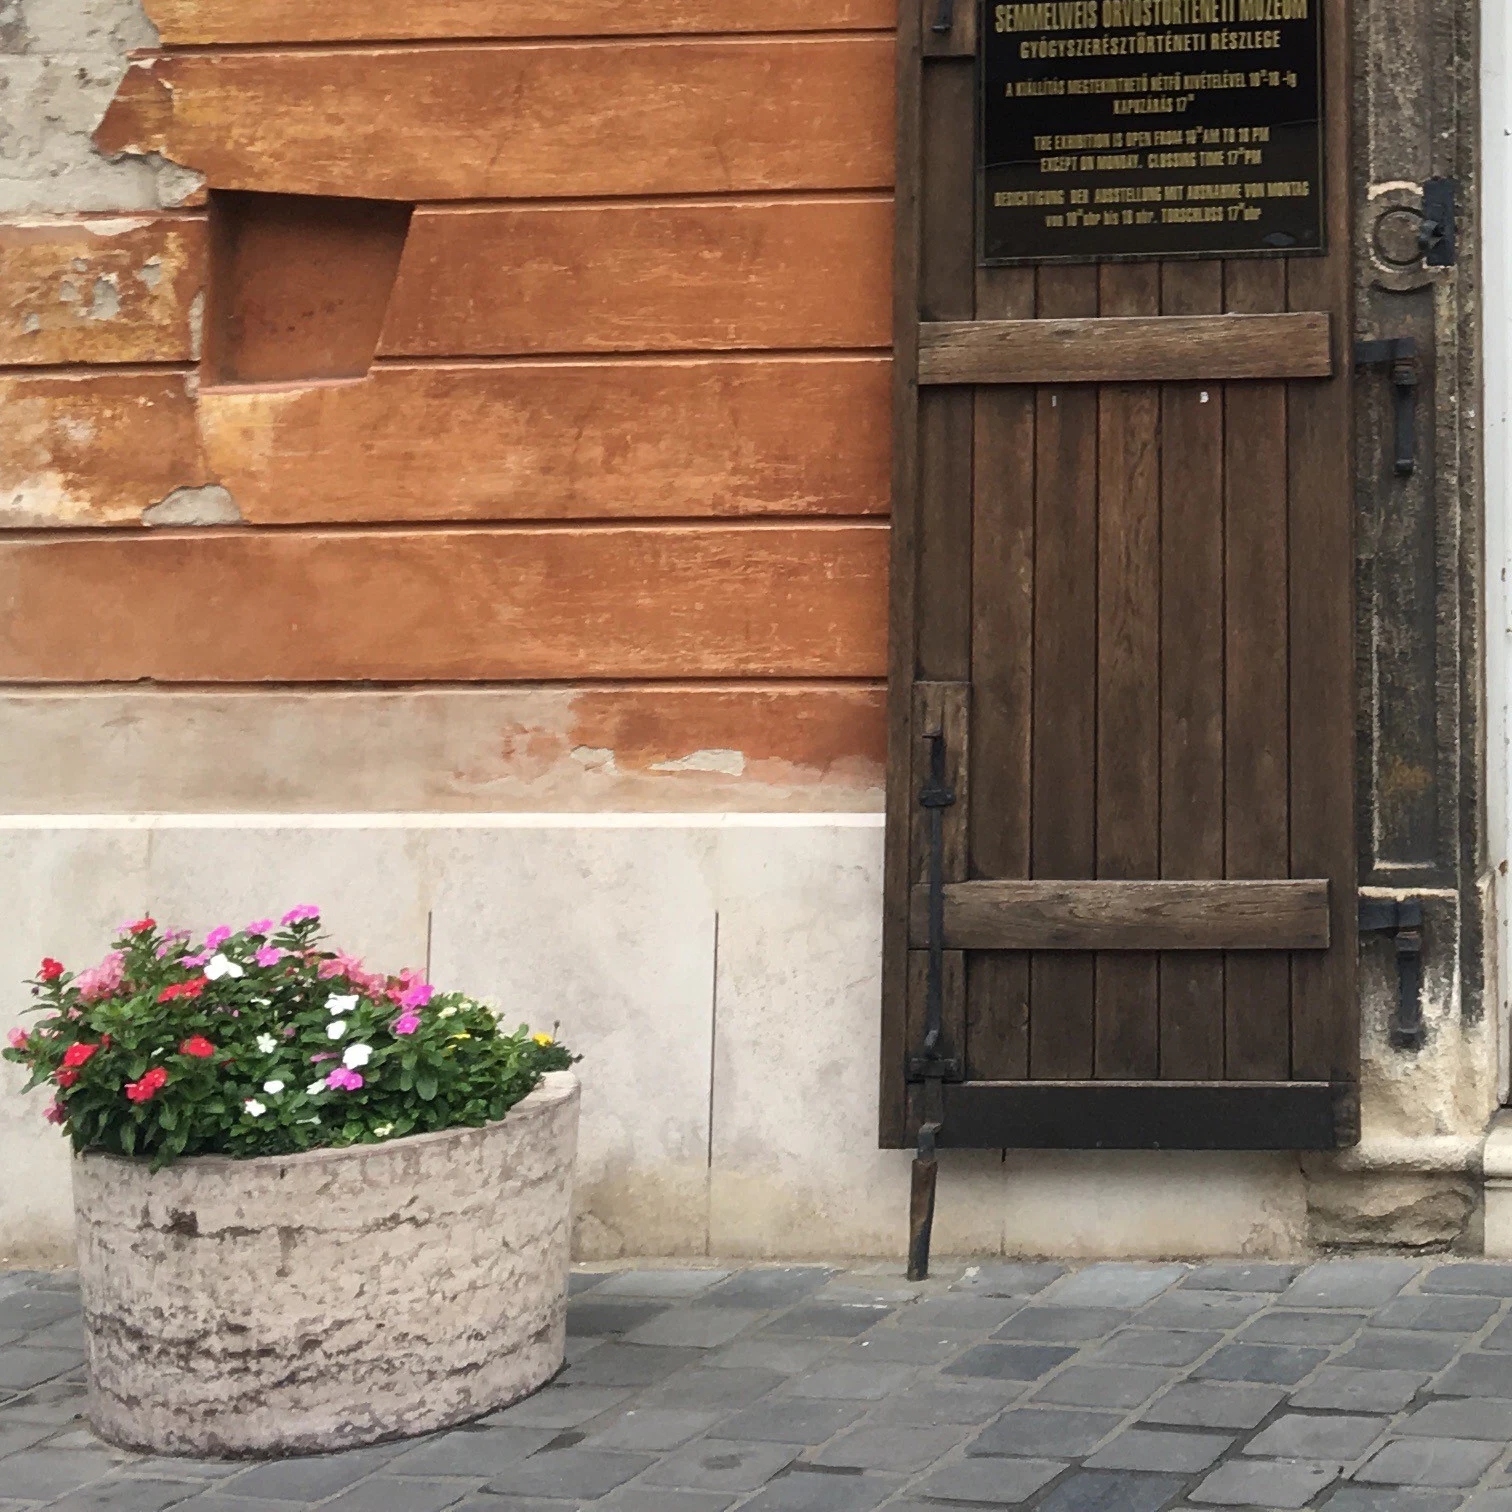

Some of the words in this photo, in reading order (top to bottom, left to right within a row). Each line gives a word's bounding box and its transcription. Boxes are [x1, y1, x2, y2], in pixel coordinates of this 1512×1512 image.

[995, 0, 1098, 33] SEMMELWEIS
[1210, 28, 1281, 51] RÉSZLEGE
[1005, 82, 1013, 97] A
[1034, 136, 1052, 150] THE
[1112, 132, 1123, 147] IS
[1125, 130, 1151, 147] OPEN
[1154, 130, 1183, 145] FROM
[1252, 126, 1270, 142] PM
[1040, 156, 1078, 172] EXCEPT
[1200, 150, 1224, 166] TIME
